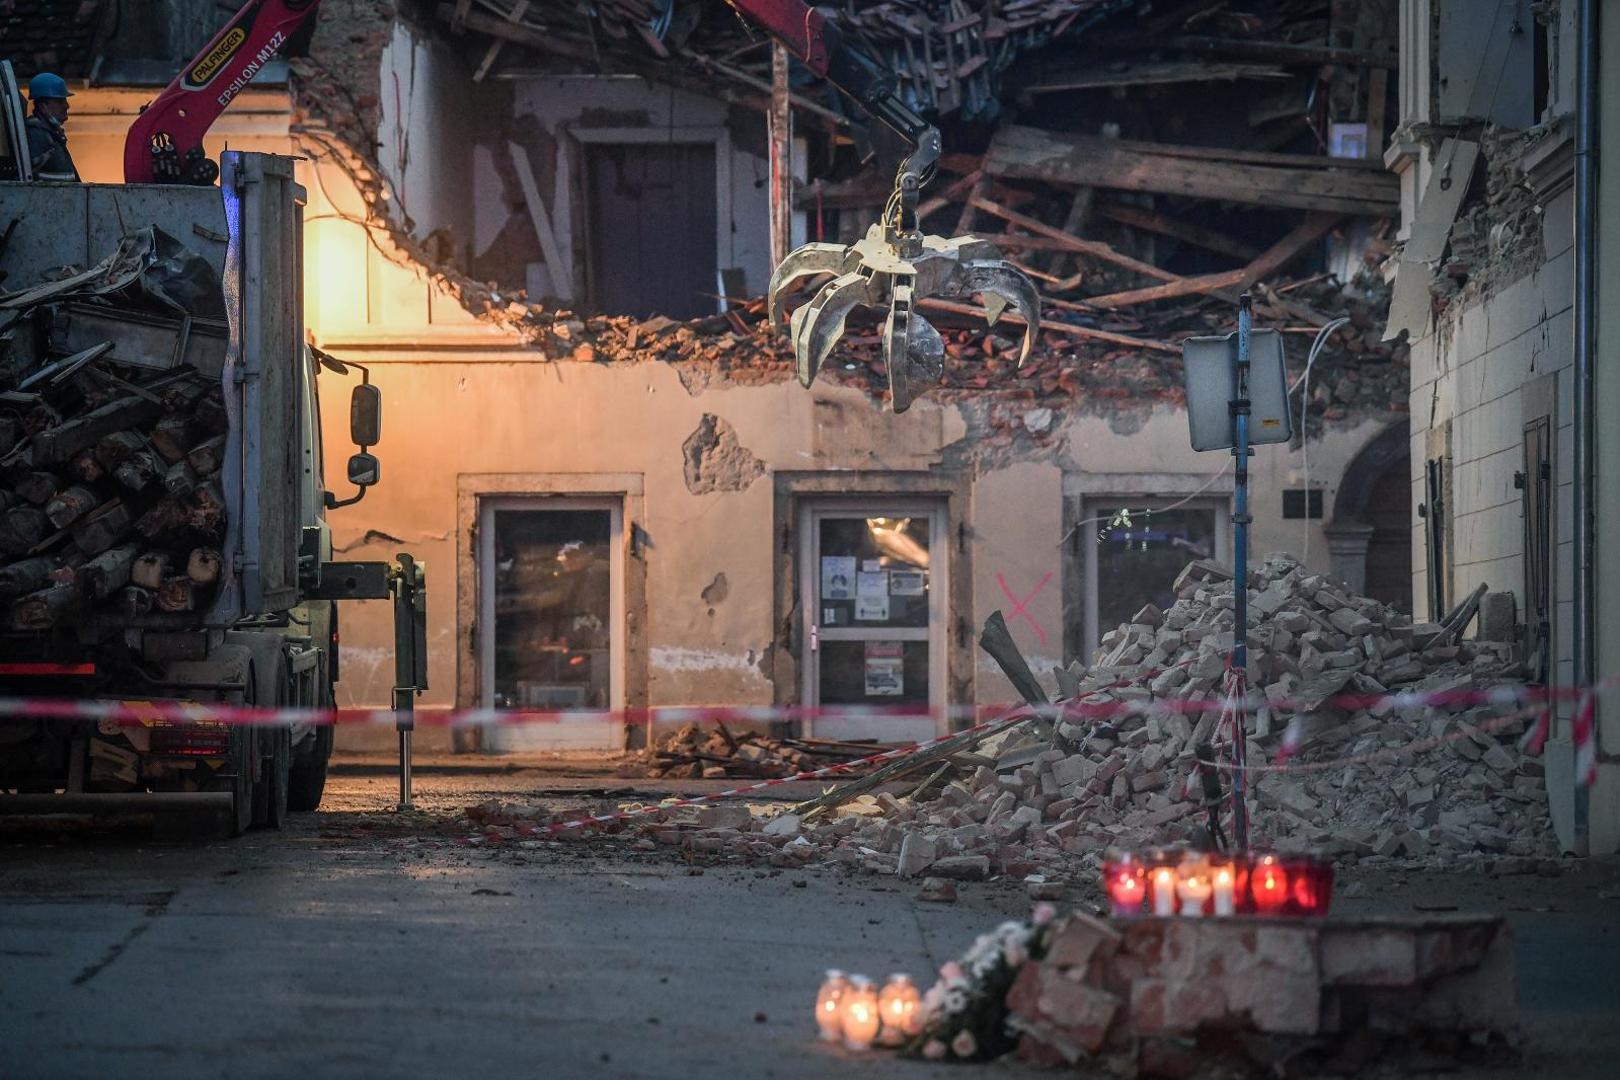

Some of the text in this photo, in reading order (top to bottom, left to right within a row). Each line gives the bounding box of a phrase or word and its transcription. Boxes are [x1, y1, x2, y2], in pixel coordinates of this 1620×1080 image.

[194, 31, 241, 80] PALFINGER
[217, 31, 286, 107] EPSILON M12Z
